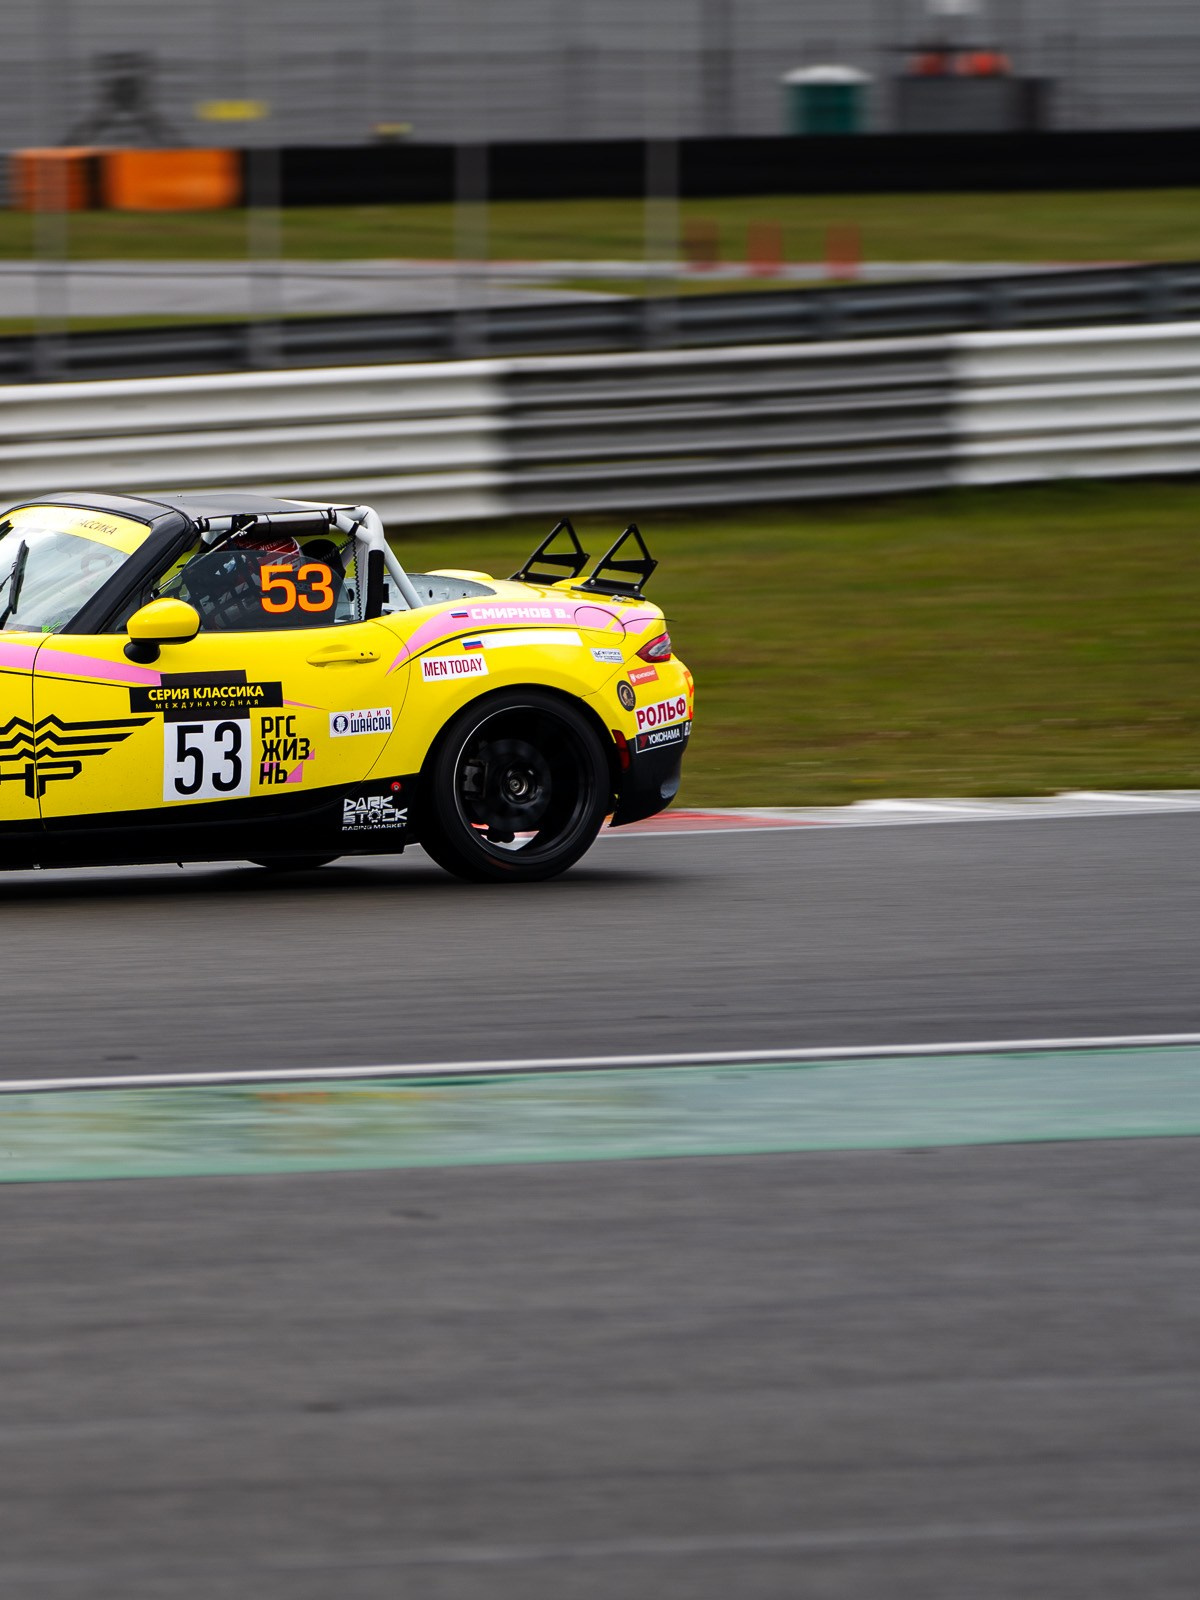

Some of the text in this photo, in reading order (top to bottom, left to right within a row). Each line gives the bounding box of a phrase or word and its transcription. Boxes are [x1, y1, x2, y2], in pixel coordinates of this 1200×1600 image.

[260, 563, 334, 614] 53
[471, 607, 571, 620] СМИРНОВ В.
[424, 658, 482, 677] MEN TODAY
[148, 685, 265, 701] СЕРИЯ КЛАССИКА
[155, 699, 259, 709] МЕЖДУНАРОДНАЯ
[350, 709, 391, 719] РАДИО
[636, 697, 686, 730] РОЛЬФ
[261, 715, 296, 738] РГС
[350, 717, 391, 733] ШАНСОН
[648, 728, 680, 744] YOKOHAMA
[174, 721, 242, 795] 53
[260, 737, 310, 762] ЖИЗ
[259, 762, 288, 785] НЬ
[343, 795, 393, 811] DARK
